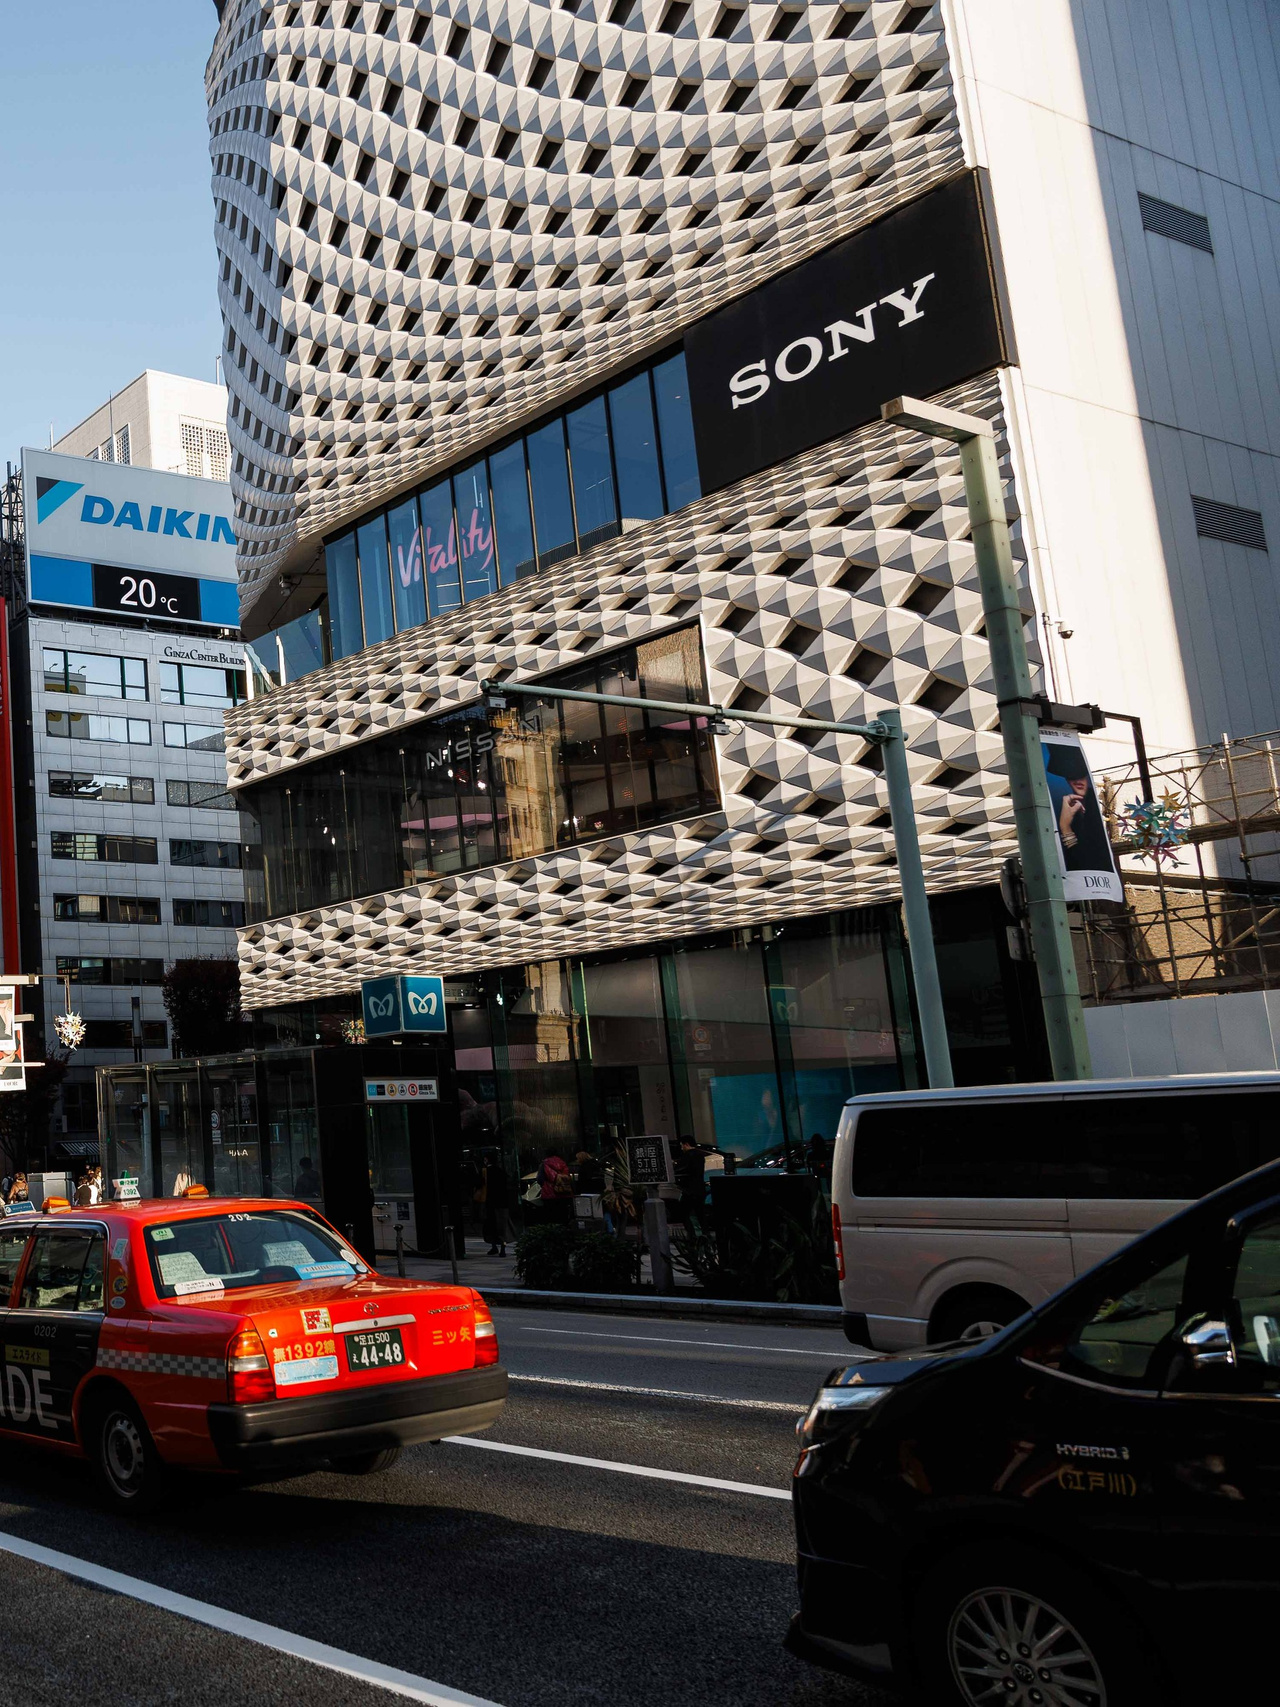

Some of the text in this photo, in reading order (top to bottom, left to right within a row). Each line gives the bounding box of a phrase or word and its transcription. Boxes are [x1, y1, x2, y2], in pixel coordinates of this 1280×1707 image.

[728, 272, 935, 410] SONY
[80, 494, 237, 546] DAIKIN
[397, 508, 494, 588] Vitality
[119, 575, 156, 609] 20
[426, 714, 540, 770] NISSN
[1084, 875, 1112, 889] DIOR
[635, 1147, 657, 1158] 銀座
[637, 1158, 657, 1168] 5丁目
[122, 1188, 137, 1196] 1392
[227, 1213, 252, 1222] 202
[34, 1324, 58, 1338] 0202
[359, 1331, 390, 1346] 足立 500
[11, 1348, 42, 1361] エスライド
[360, 1342, 402, 1366] 44-48
[1056, 1443, 1117, 1459] HYBRID
